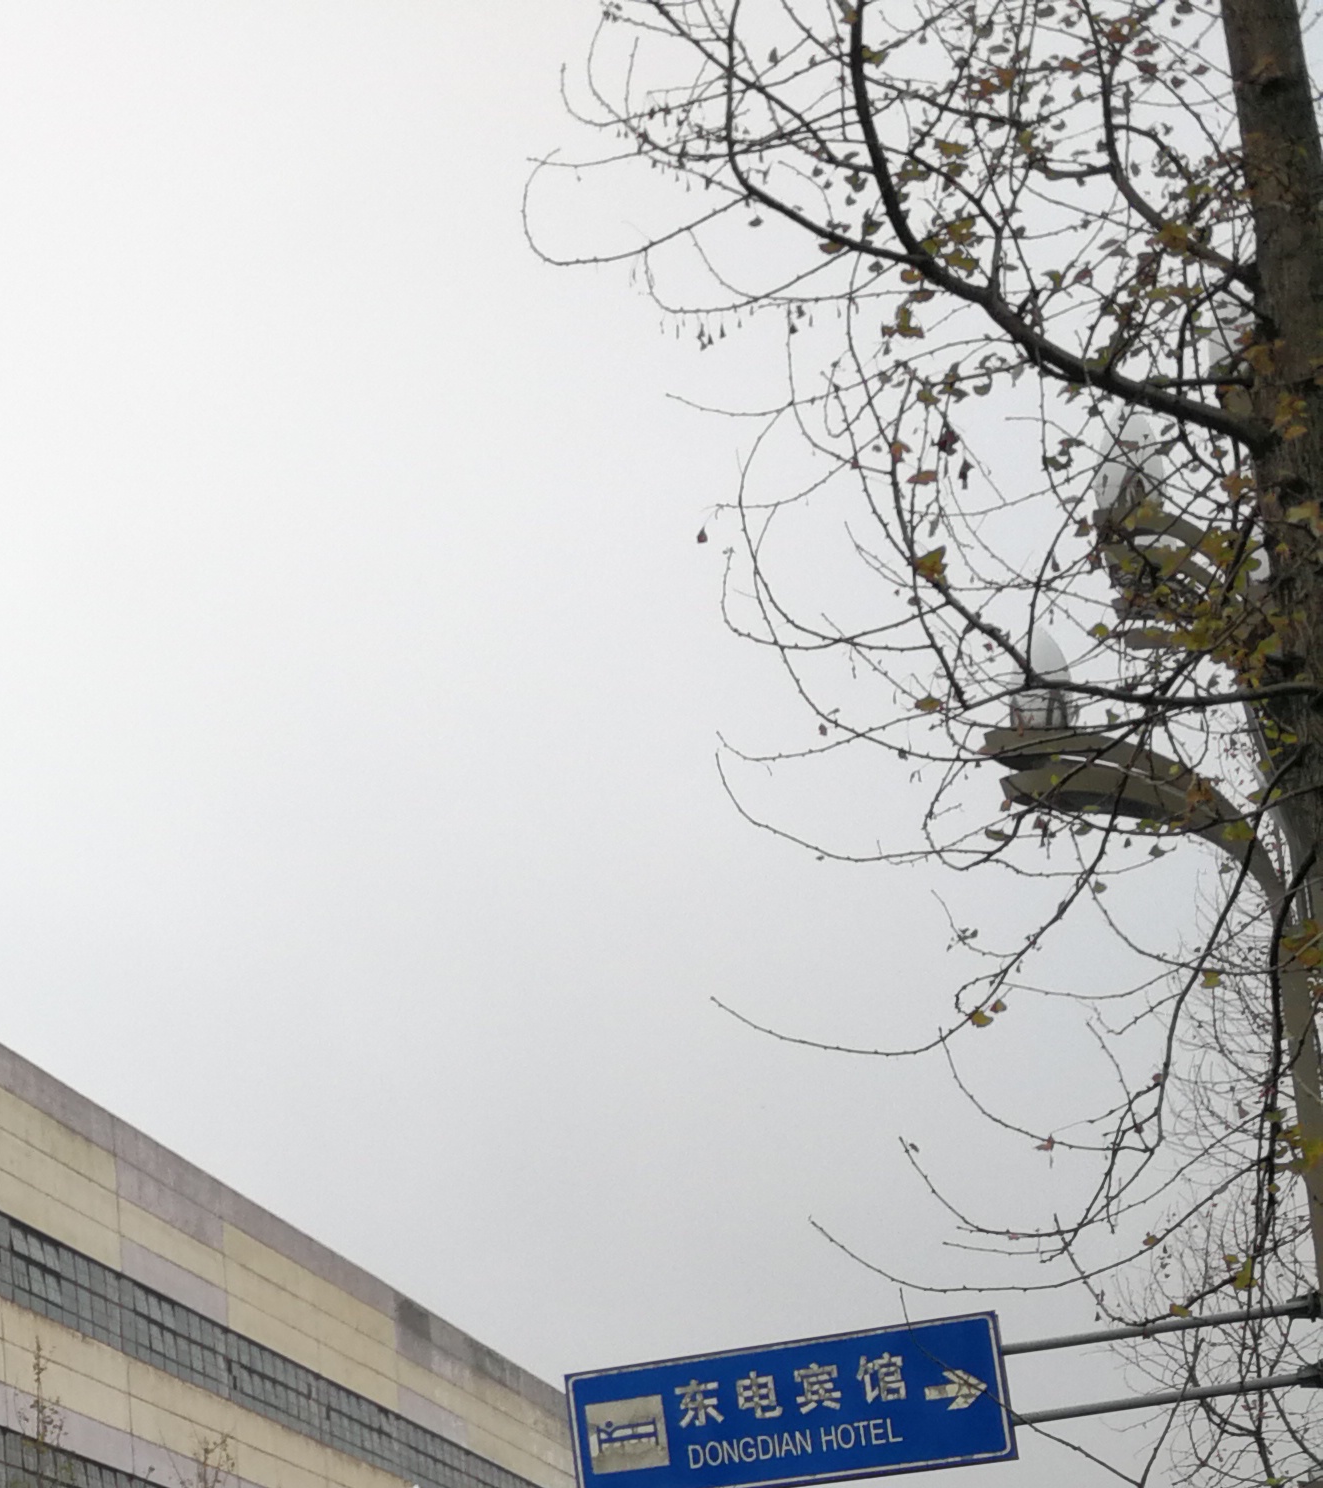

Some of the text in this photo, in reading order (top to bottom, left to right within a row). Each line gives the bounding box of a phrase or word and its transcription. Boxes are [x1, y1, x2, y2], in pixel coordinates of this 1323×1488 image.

[674, 1352, 907, 1428] 东电宾馆
[687, 1418, 903, 1470] DONGDIAN HOTEL
